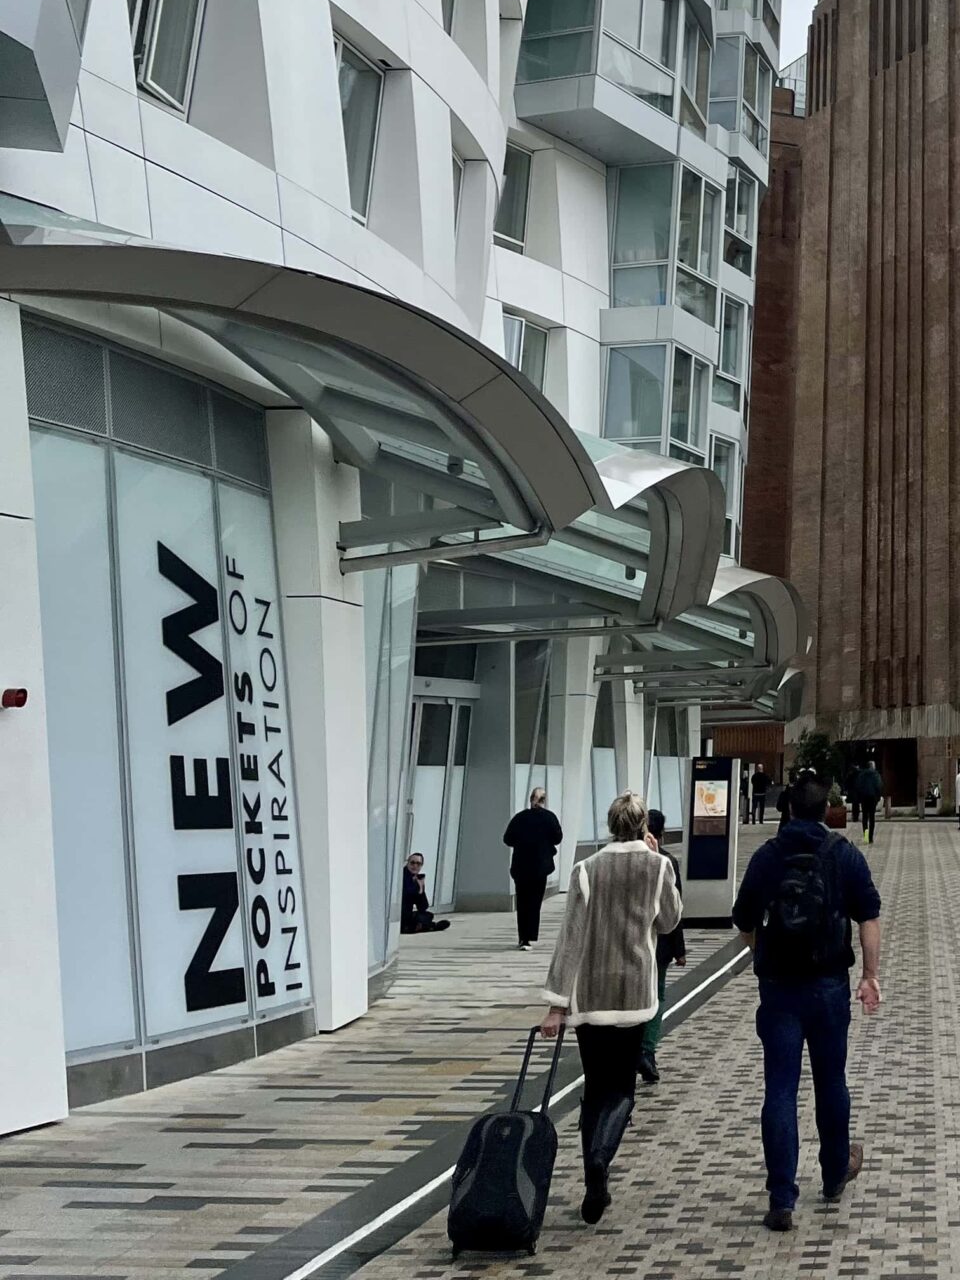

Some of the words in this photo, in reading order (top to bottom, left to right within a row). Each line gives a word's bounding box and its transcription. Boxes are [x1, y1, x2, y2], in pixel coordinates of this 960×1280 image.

[226, 555, 248, 636] OF
[157, 540, 247, 1012] NEW
[233, 671, 276, 998] POCKETS
[254, 597, 303, 991] INSPIRATION
